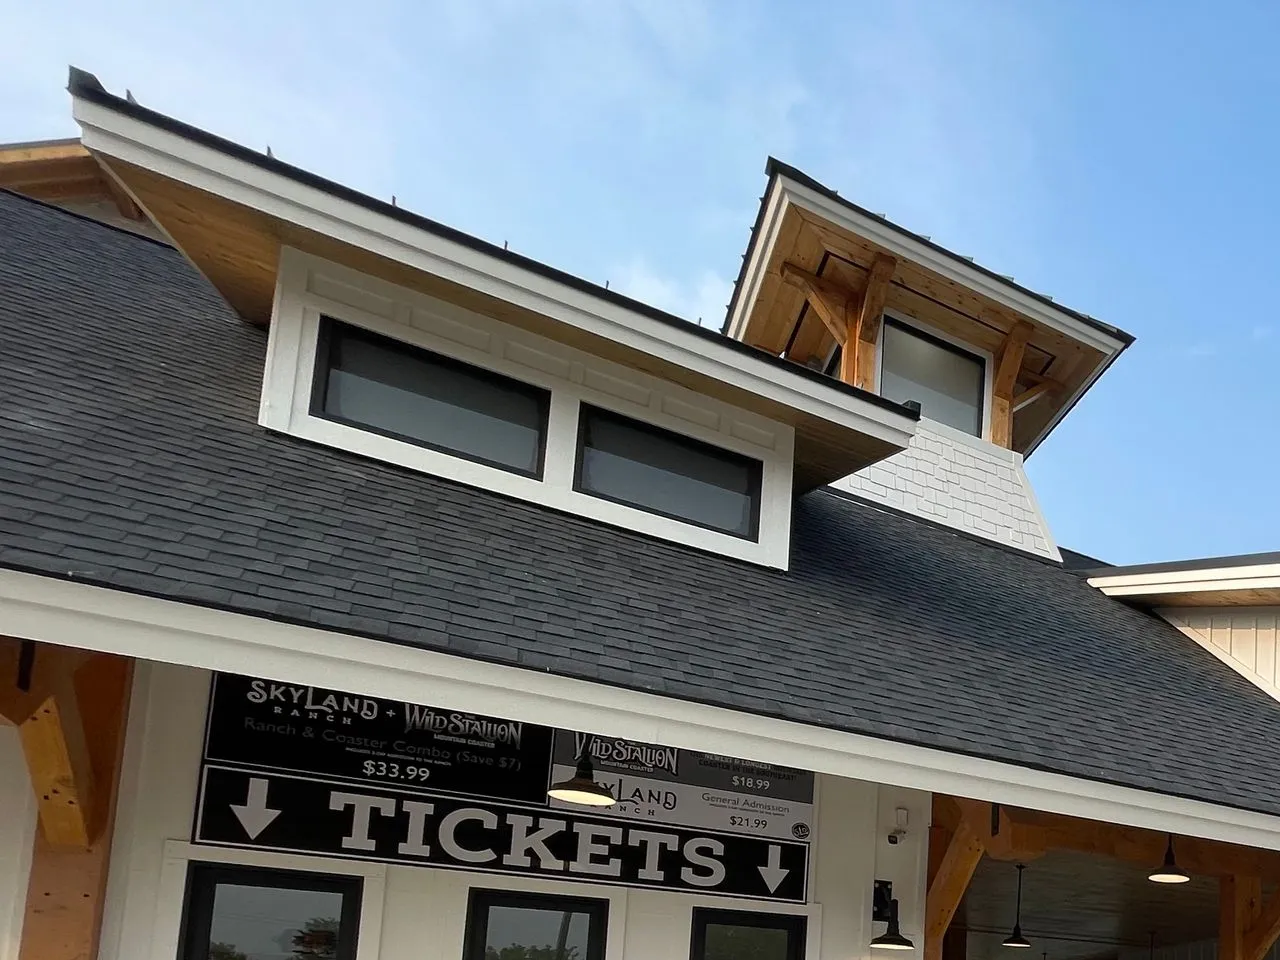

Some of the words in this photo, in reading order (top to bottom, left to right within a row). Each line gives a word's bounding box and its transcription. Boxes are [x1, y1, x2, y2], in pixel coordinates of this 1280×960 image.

[246, 680, 379, 721] SKYLAND
[273, 705, 352, 726] RANCH
[403, 702, 447, 735] WILD
[447, 713, 522, 750] STALLION
[243, 715, 296, 737] Ranch
[302, 727, 315, 739] &
[321, 729, 388, 751] Coaster
[392, 739, 452, 760] Combo
[455, 748, 494, 767] (Save
[498, 755, 522, 772] $7)
[612, 740, 678, 775] STALLION
[362, 759, 431, 782] $33.99
[731, 775, 770, 790] $18.99
[702, 792, 740, 806] General
[742, 799, 790, 814] Admission
[729, 816, 768, 829] $21.99
[328, 790, 726, 887] TICKETS
